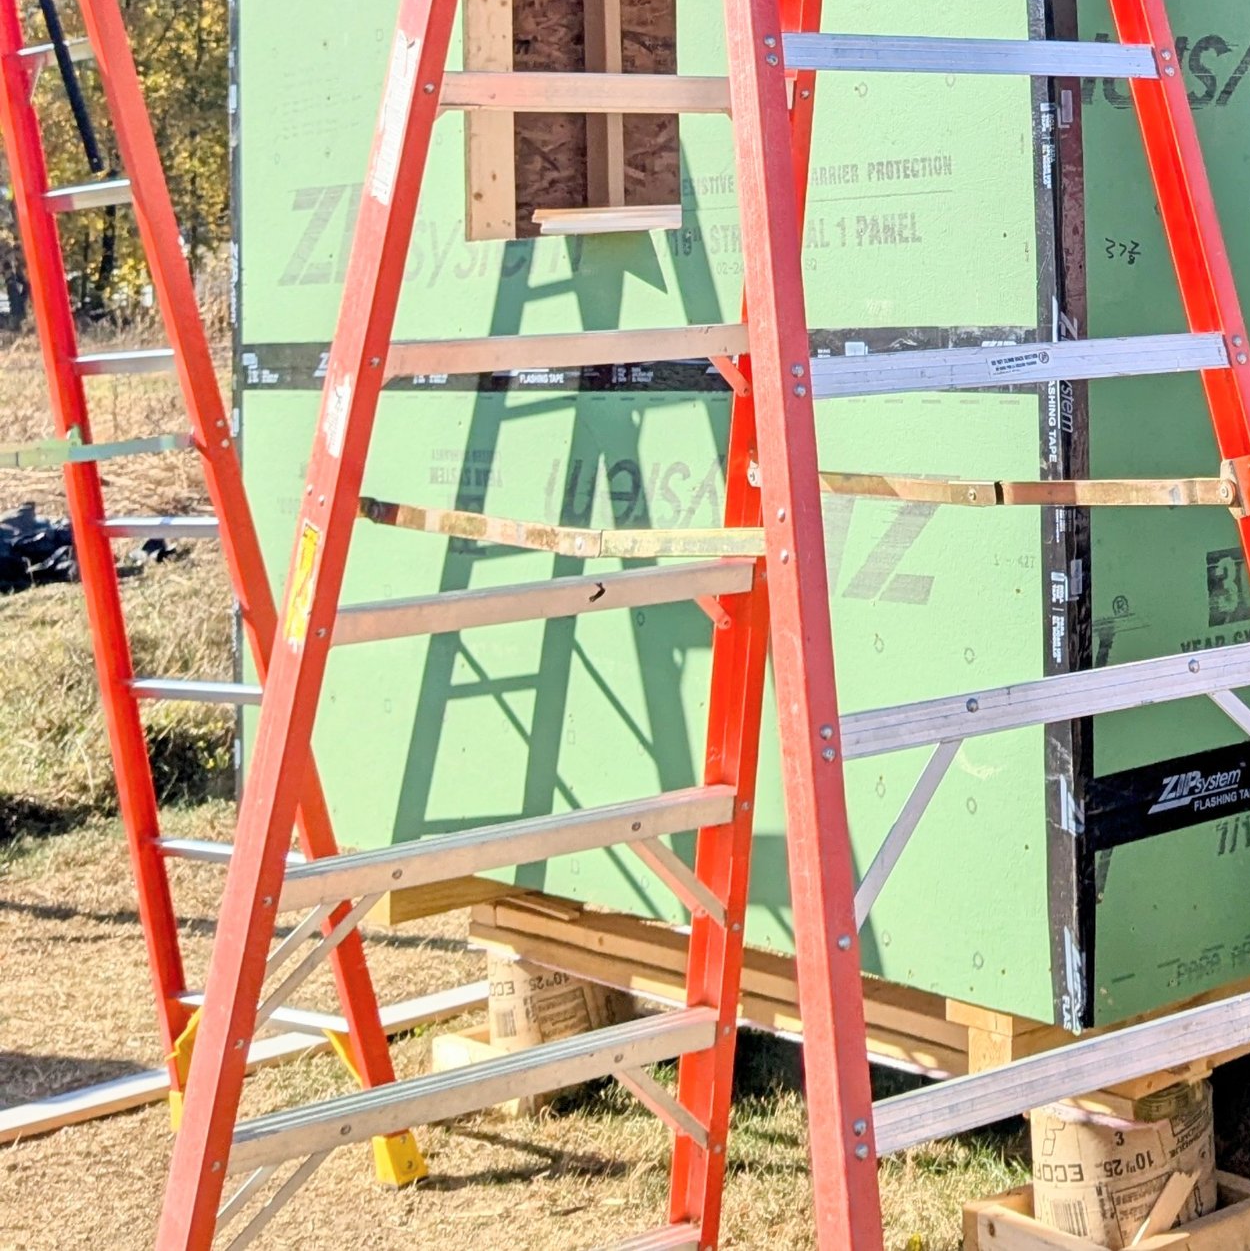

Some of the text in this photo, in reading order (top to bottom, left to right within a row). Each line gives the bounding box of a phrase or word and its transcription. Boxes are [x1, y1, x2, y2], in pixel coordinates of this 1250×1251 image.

[810, 164, 860, 187] ARRIER
[867, 155, 953, 181] PROTECTION
[855, 212, 923, 248] PANEL
[1047, 380, 1058, 463] ASHING TAPE
[1194, 793, 1238, 812] FLASHING
[1103, 1159, 1123, 1178] 25
